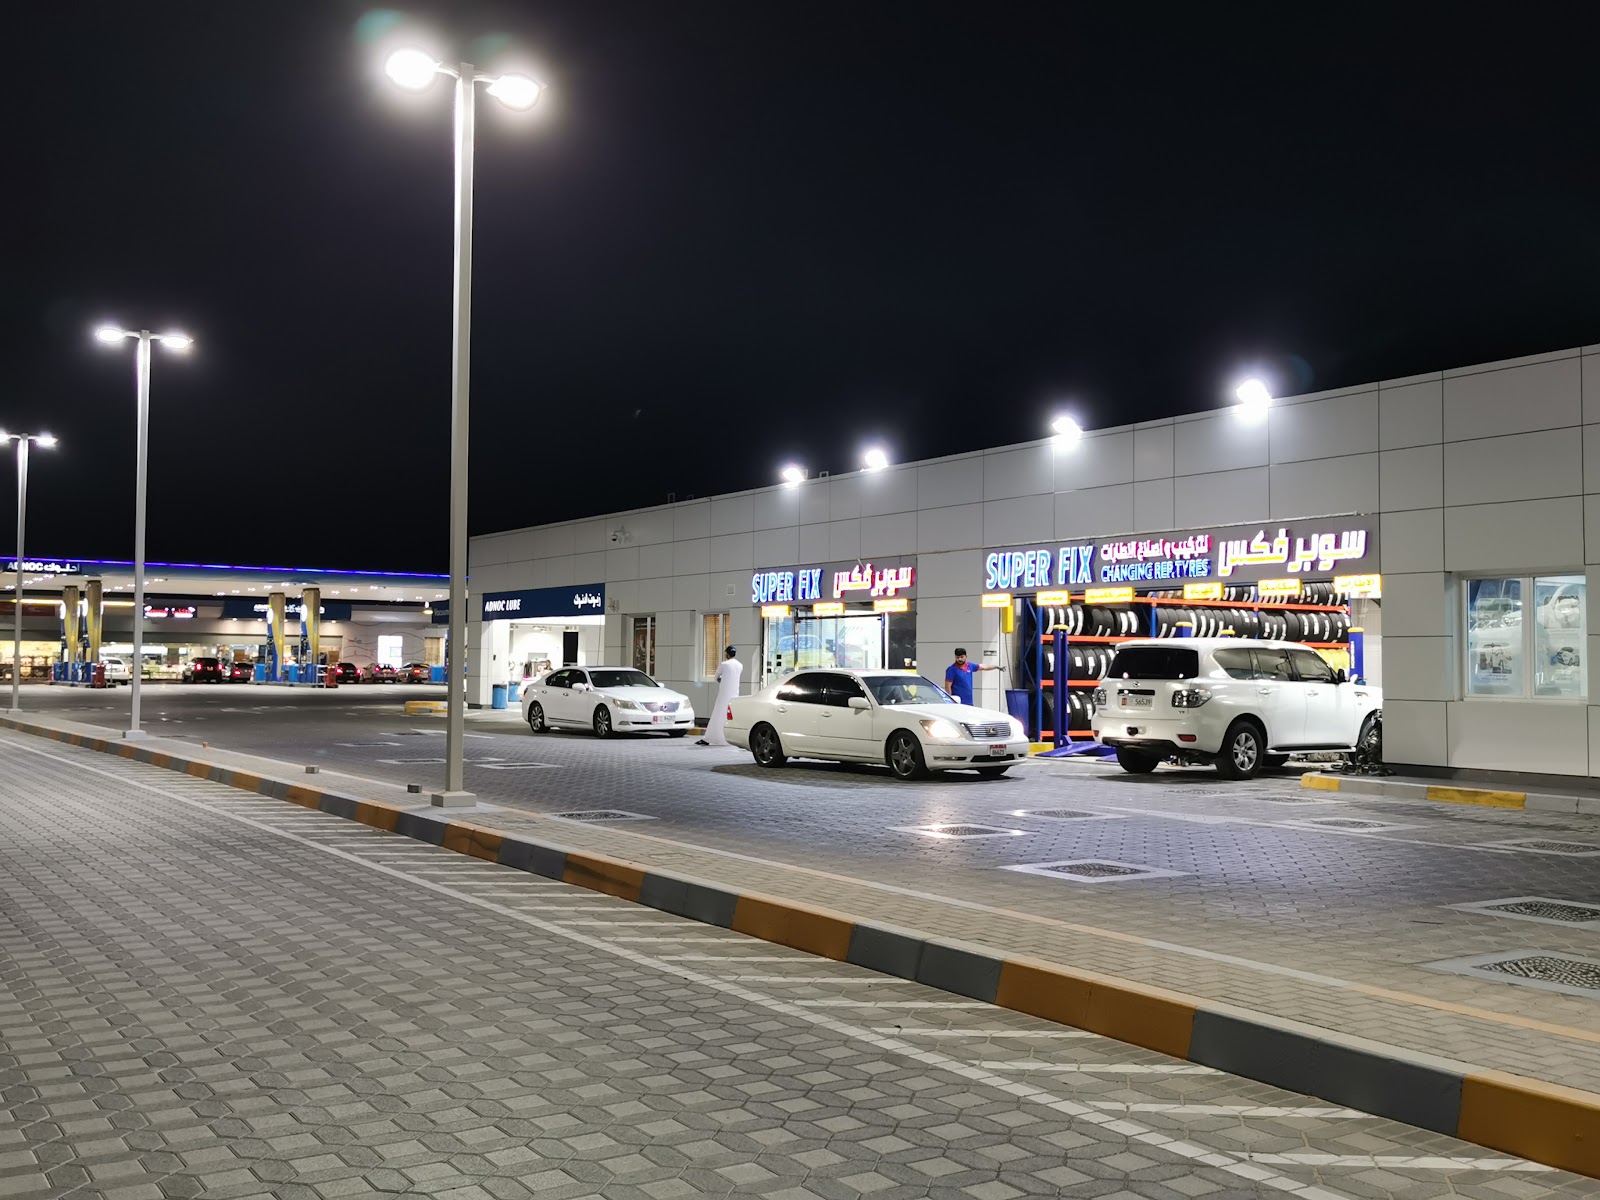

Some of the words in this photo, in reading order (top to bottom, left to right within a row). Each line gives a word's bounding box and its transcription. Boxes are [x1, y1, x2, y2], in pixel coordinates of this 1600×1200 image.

[985, 550, 1051, 590] SUPER
[1058, 545, 1095, 585] FIX
[1217, 528, 1290, 577] فكس
[1287, 530, 1367, 573] سوبر
[752, 571, 794, 603] SUPER
[798, 568, 823, 600] FIX
[1101, 562, 1153, 583] CHANGING
[485, 600, 506, 612] ADNOC
[506, 599, 522, 611] LUBE
